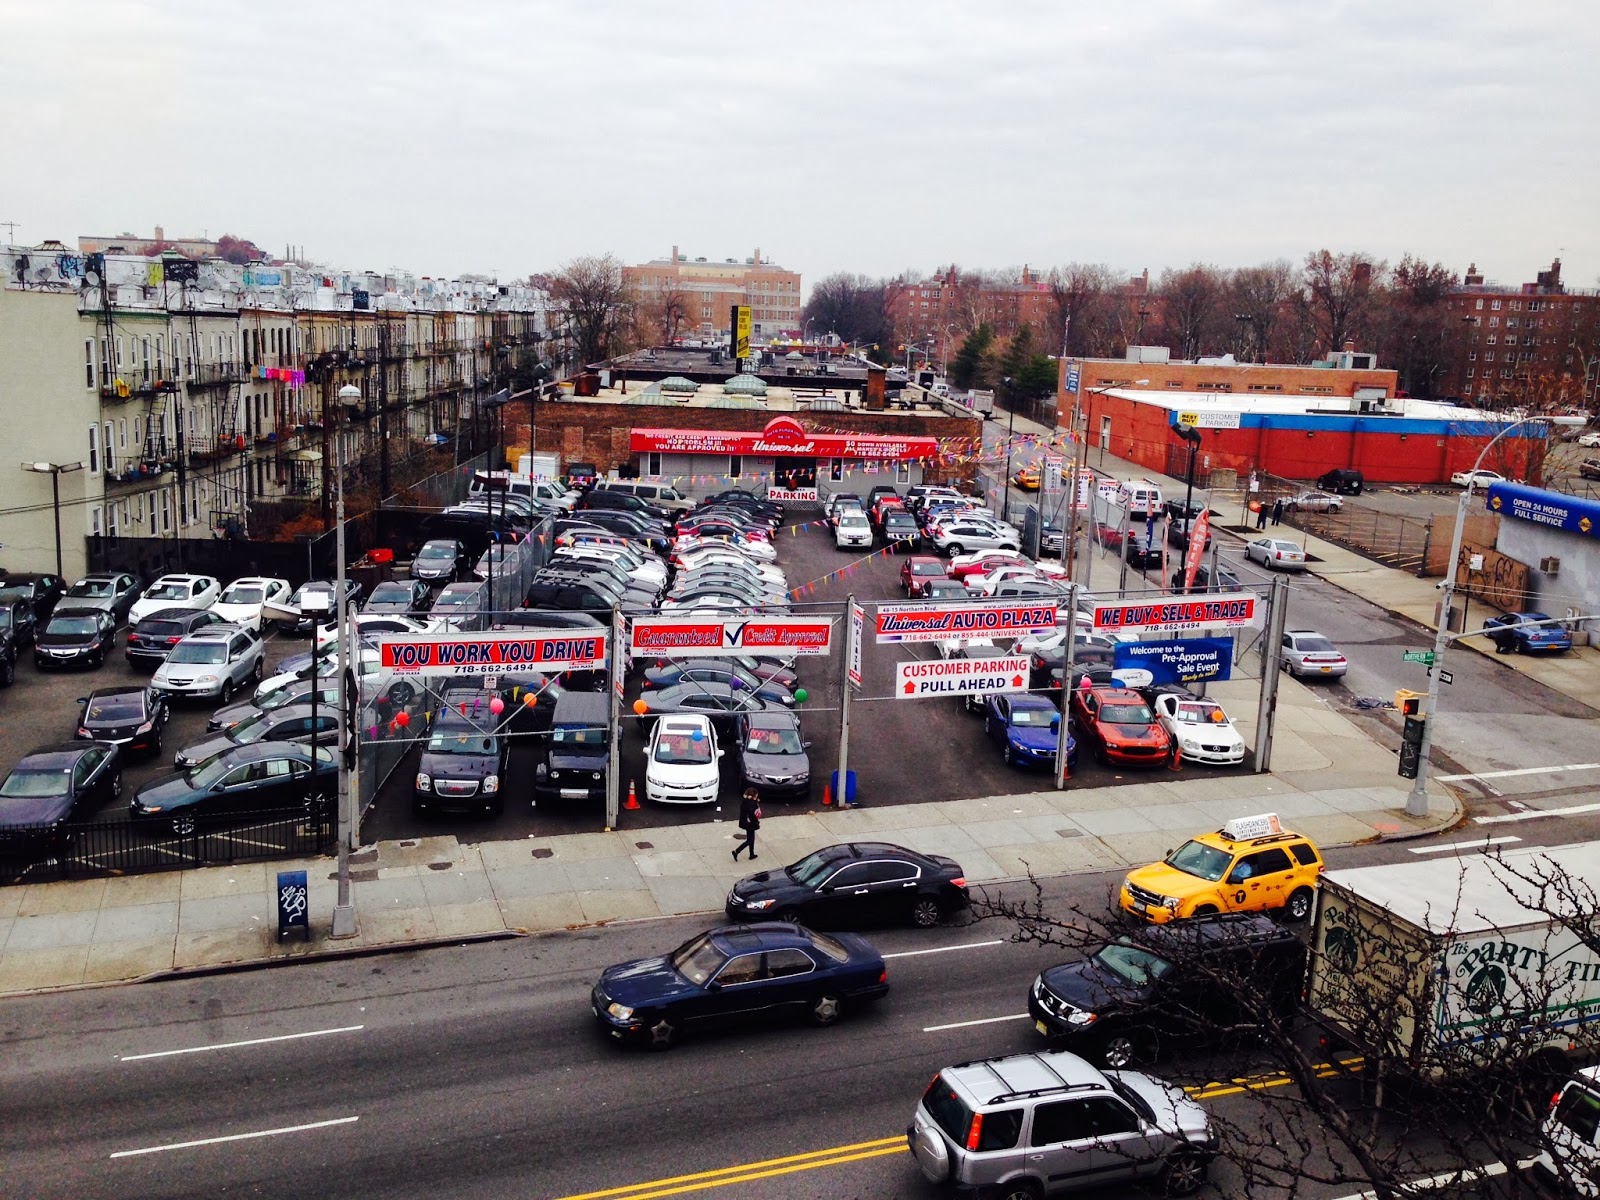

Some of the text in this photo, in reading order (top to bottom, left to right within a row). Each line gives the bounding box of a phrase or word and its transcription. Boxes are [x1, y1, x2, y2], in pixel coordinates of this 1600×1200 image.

[1200, 413, 1239, 421] CUSTOMER
[1205, 419, 1236, 427] PARKING
[752, 440, 815, 453] Universal
[770, 490, 816, 500] PARKING
[1513, 498, 1532, 509] OPEN
[1532, 503, 1542, 511] 24
[1542, 505, 1569, 518] HOURS
[1514, 508, 1532, 520] FULL
[1532, 513, 1563, 528] SERVICE
[1100, 600, 1249, 626] WE BUY SELL & TRADE
[881, 609, 1054, 633] Universal AUTO PLAZA
[638, 627, 720, 647] Guaranteed
[745, 627, 828, 646] Credit Approval
[904, 633, 951, 641] 718-662-6494
[391, 643, 431, 666] YOU
[437, 641, 494, 665] WORK
[498, 641, 537, 663] YOU
[541, 638, 597, 661] DRIVE
[1130, 647, 1164, 655] Welcome
[1162, 651, 1217, 663] Pre-Approval
[454, 663, 534, 674] 718-662-6494
[903, 659, 1028, 677] CUSTOMER PARKING
[1177, 661, 1220, 673] Sale Event
[920, 677, 1006, 693] PULL AHEAD
[1235, 819, 1269, 830] FLASHDANCERS
[1451, 942, 1469, 956] It's
